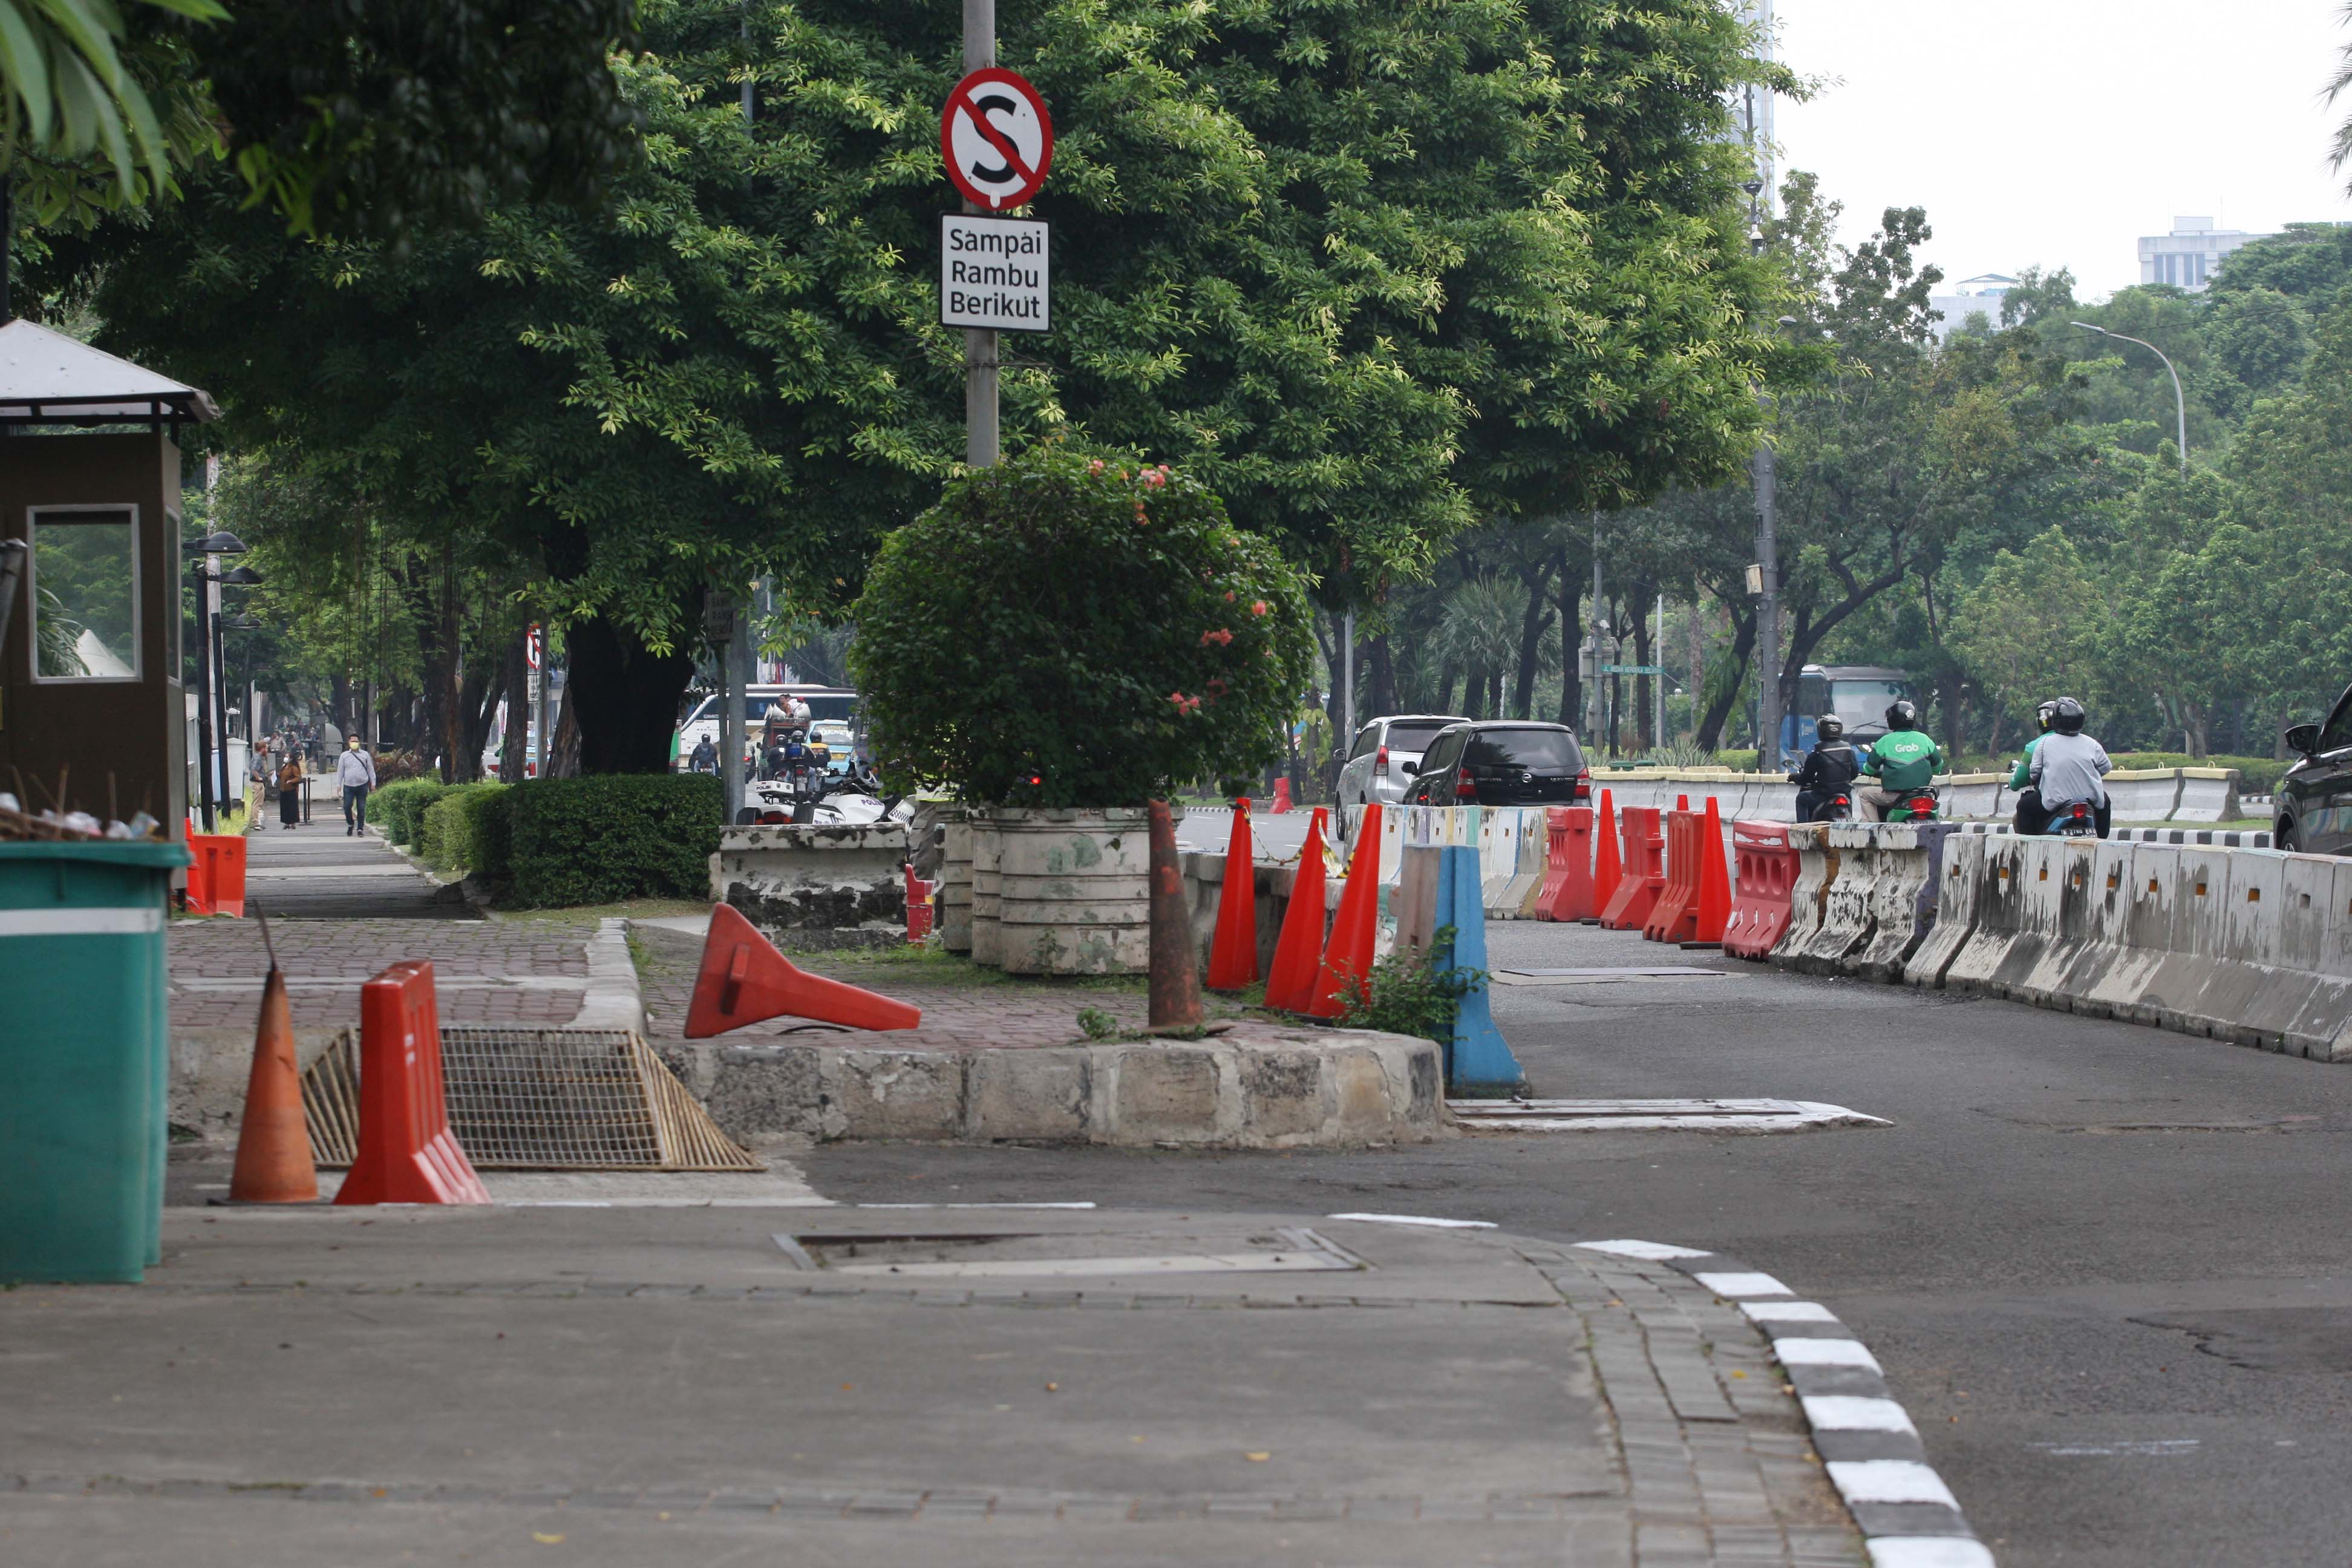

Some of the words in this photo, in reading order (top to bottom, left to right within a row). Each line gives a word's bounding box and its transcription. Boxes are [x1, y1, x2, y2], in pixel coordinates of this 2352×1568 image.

[972, 94, 1020, 183] S
[950, 229, 1041, 259] Sampai
[952, 261, 1039, 288] Rambu
[950, 290, 1040, 319] Berikut
[1895, 743, 1919, 753] Grab
